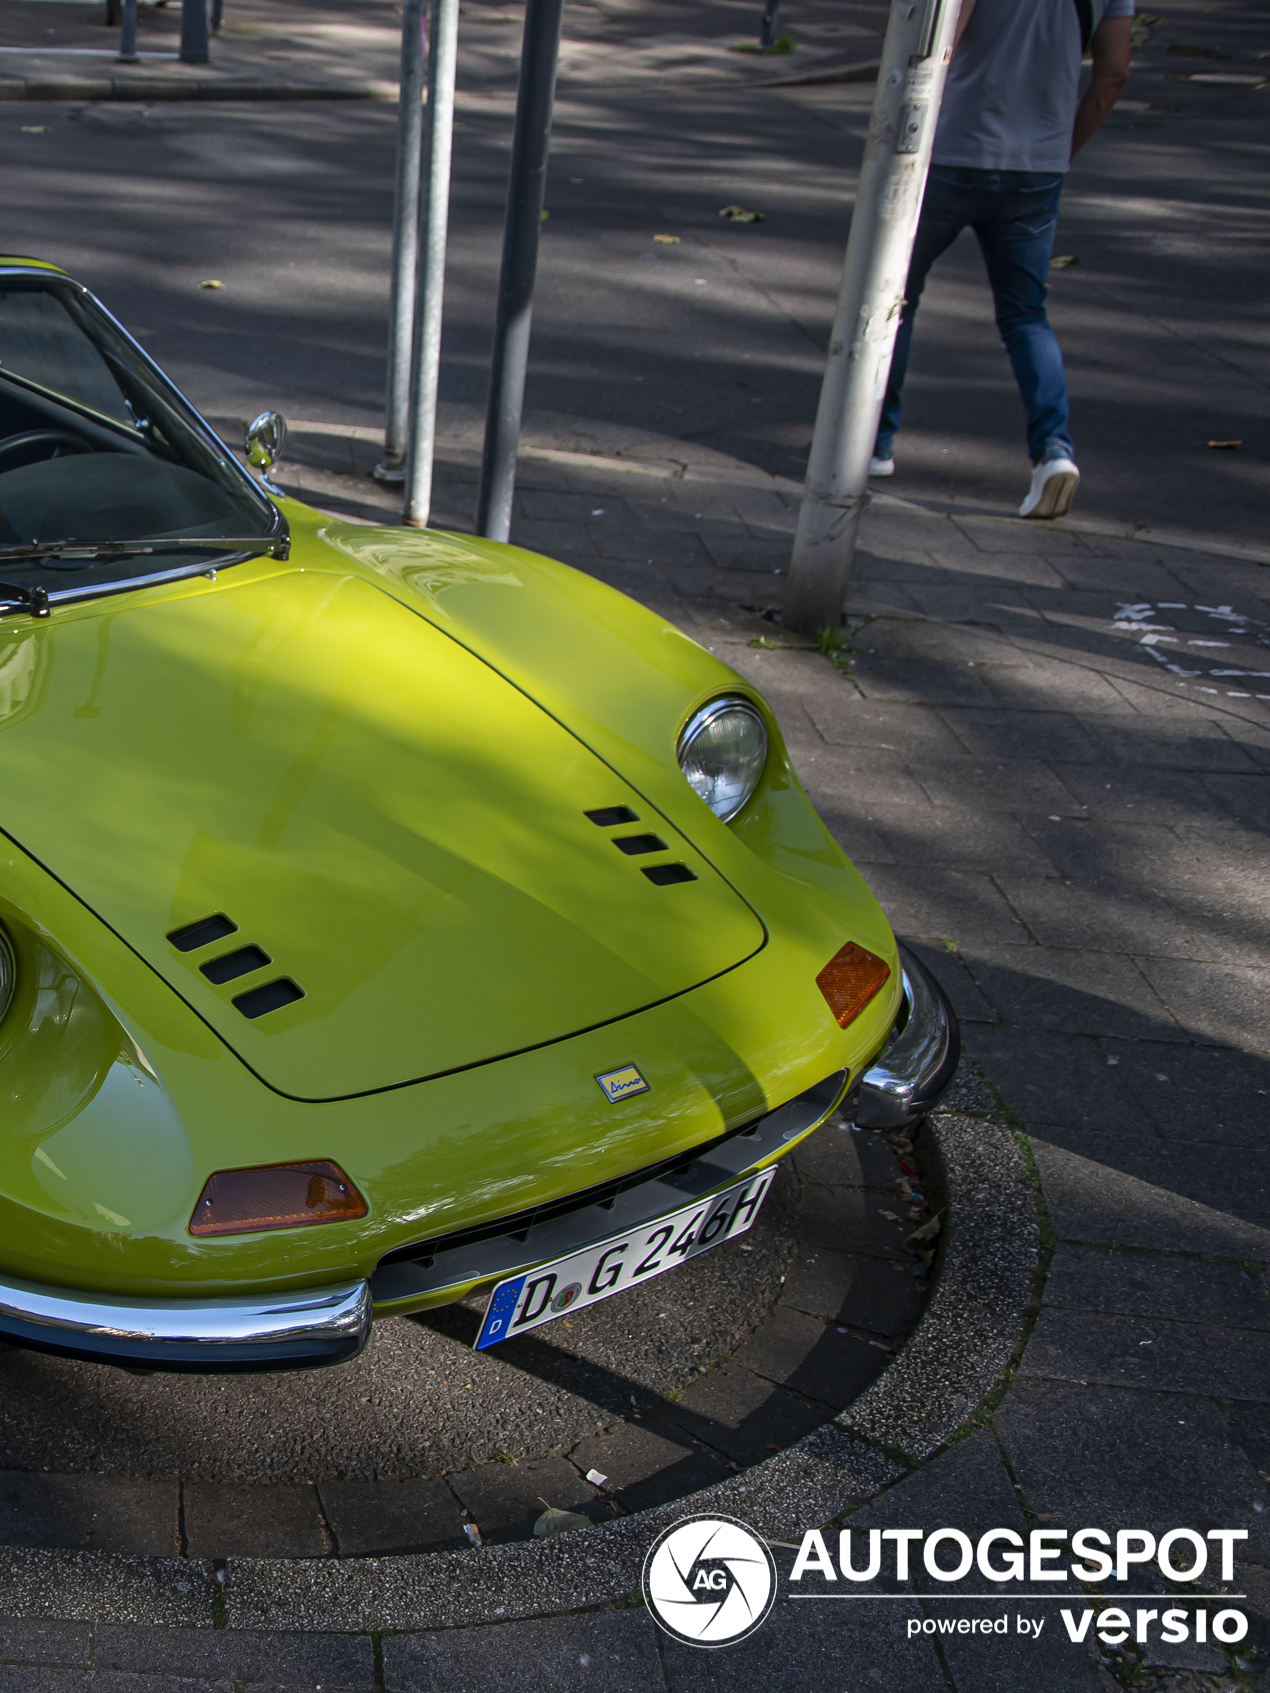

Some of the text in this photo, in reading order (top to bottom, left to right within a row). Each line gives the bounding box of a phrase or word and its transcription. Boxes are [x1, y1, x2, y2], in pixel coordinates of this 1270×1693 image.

[610, 1077, 642, 1094] Dino
[512, 1273, 558, 1328] D
[588, 1243, 629, 1295] G
[633, 1177, 769, 1278] 246H
